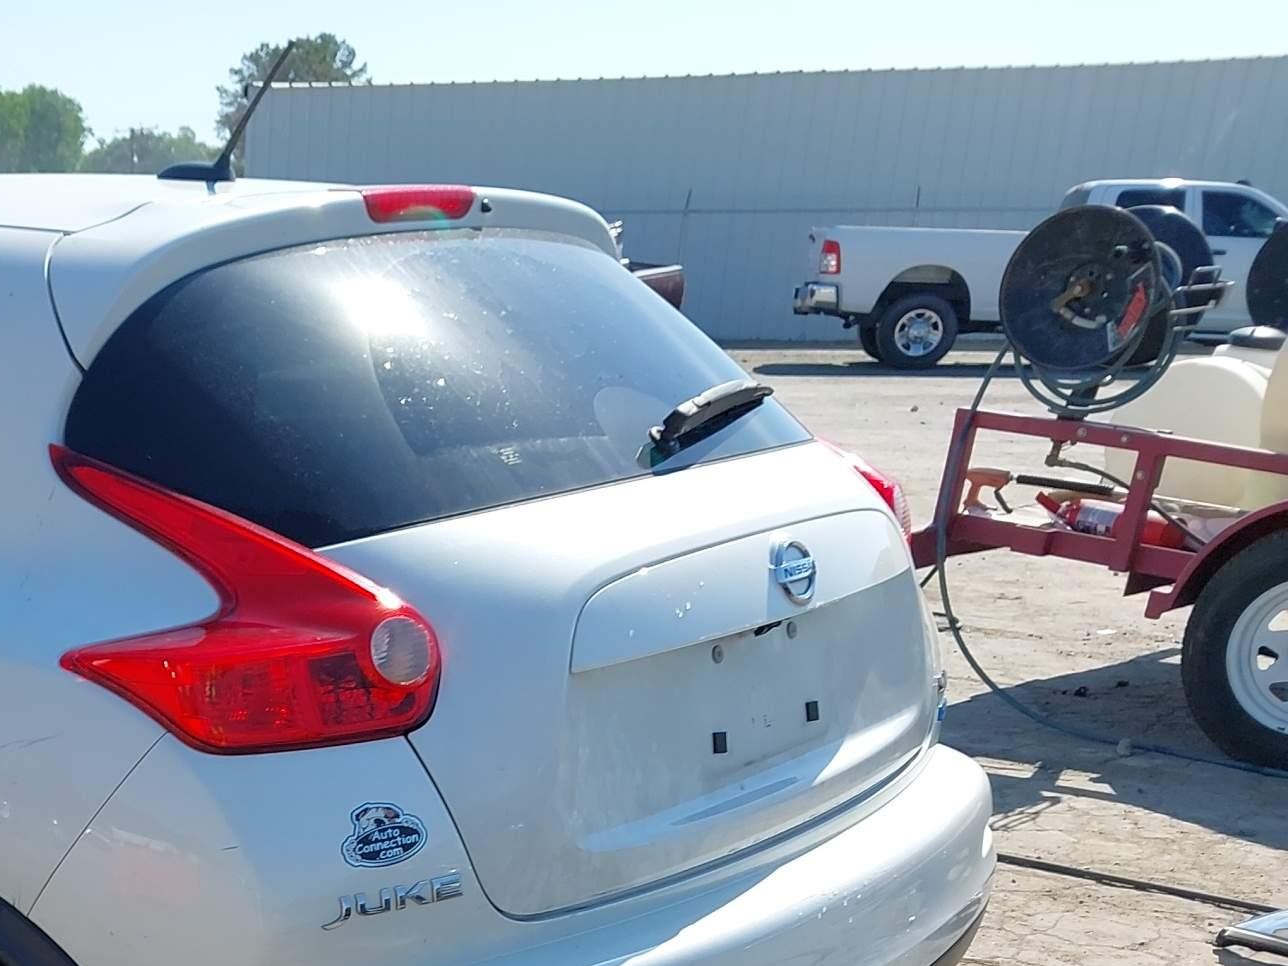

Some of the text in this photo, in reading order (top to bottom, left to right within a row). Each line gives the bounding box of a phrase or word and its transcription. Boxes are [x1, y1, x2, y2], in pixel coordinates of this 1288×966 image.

[784, 559, 813, 579] NISS
[355, 833, 420, 855] Connection
[372, 828, 400, 841] Auto
[376, 847, 404, 860] .com
[320, 872, 463, 931] JUKE
